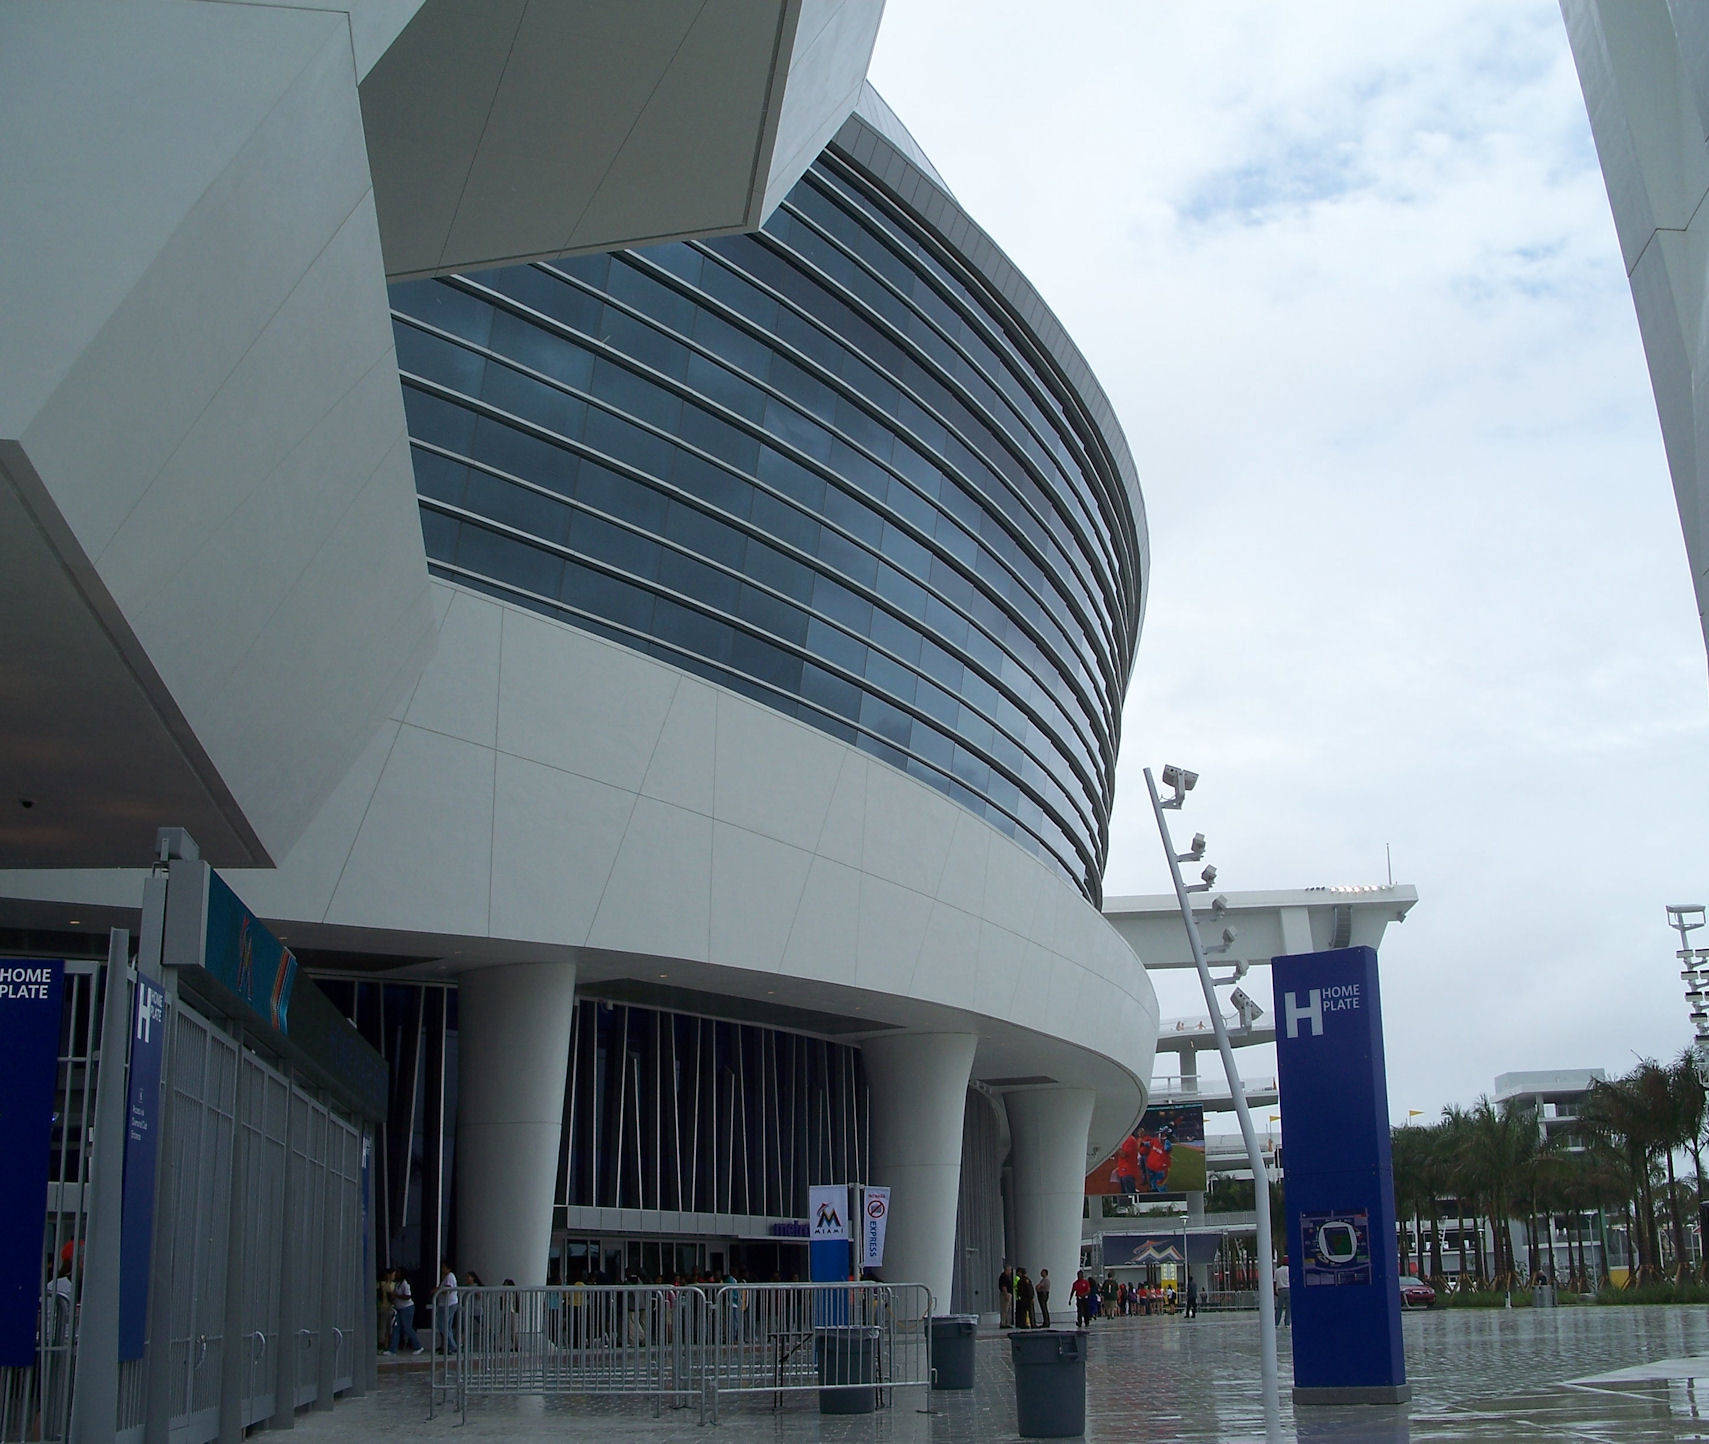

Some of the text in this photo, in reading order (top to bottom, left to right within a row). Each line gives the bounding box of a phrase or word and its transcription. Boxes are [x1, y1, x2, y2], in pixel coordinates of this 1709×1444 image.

[0, 968, 52, 983] HOME
[0, 985, 49, 999] PLATE
[1322, 984, 1360, 999] HOME
[1323, 997, 1360, 1012] PLATE
[137, 982, 152, 1044] H
[1284, 988, 1324, 1039] H
[869, 1220, 877, 1257] EXPRESS
